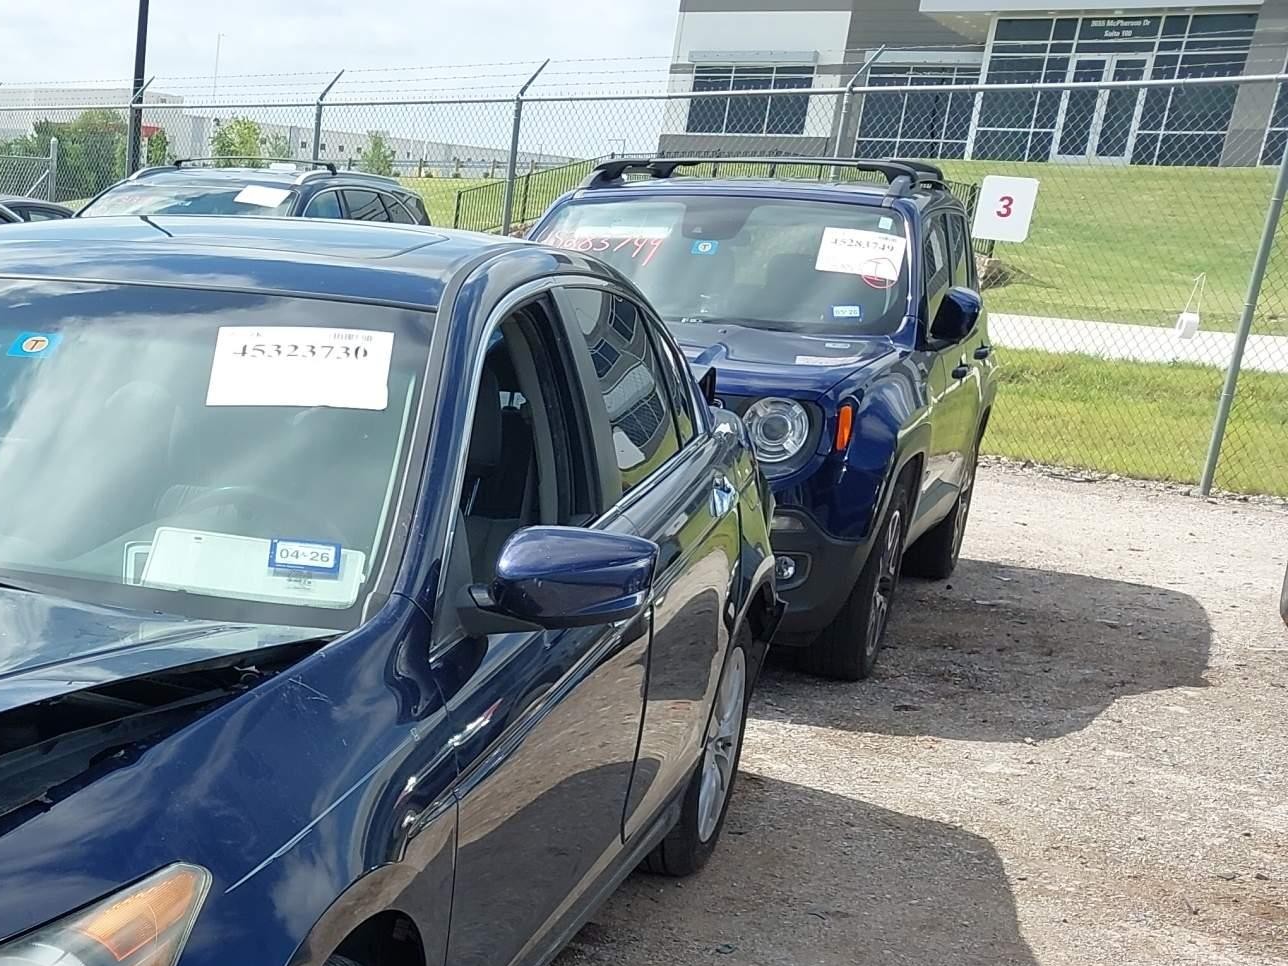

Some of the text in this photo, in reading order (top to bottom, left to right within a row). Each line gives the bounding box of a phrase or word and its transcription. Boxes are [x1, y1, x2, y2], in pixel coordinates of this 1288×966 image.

[996, 196, 1014, 218] 3
[30, 339, 46, 351] T
[232, 344, 368, 360] 45323730
